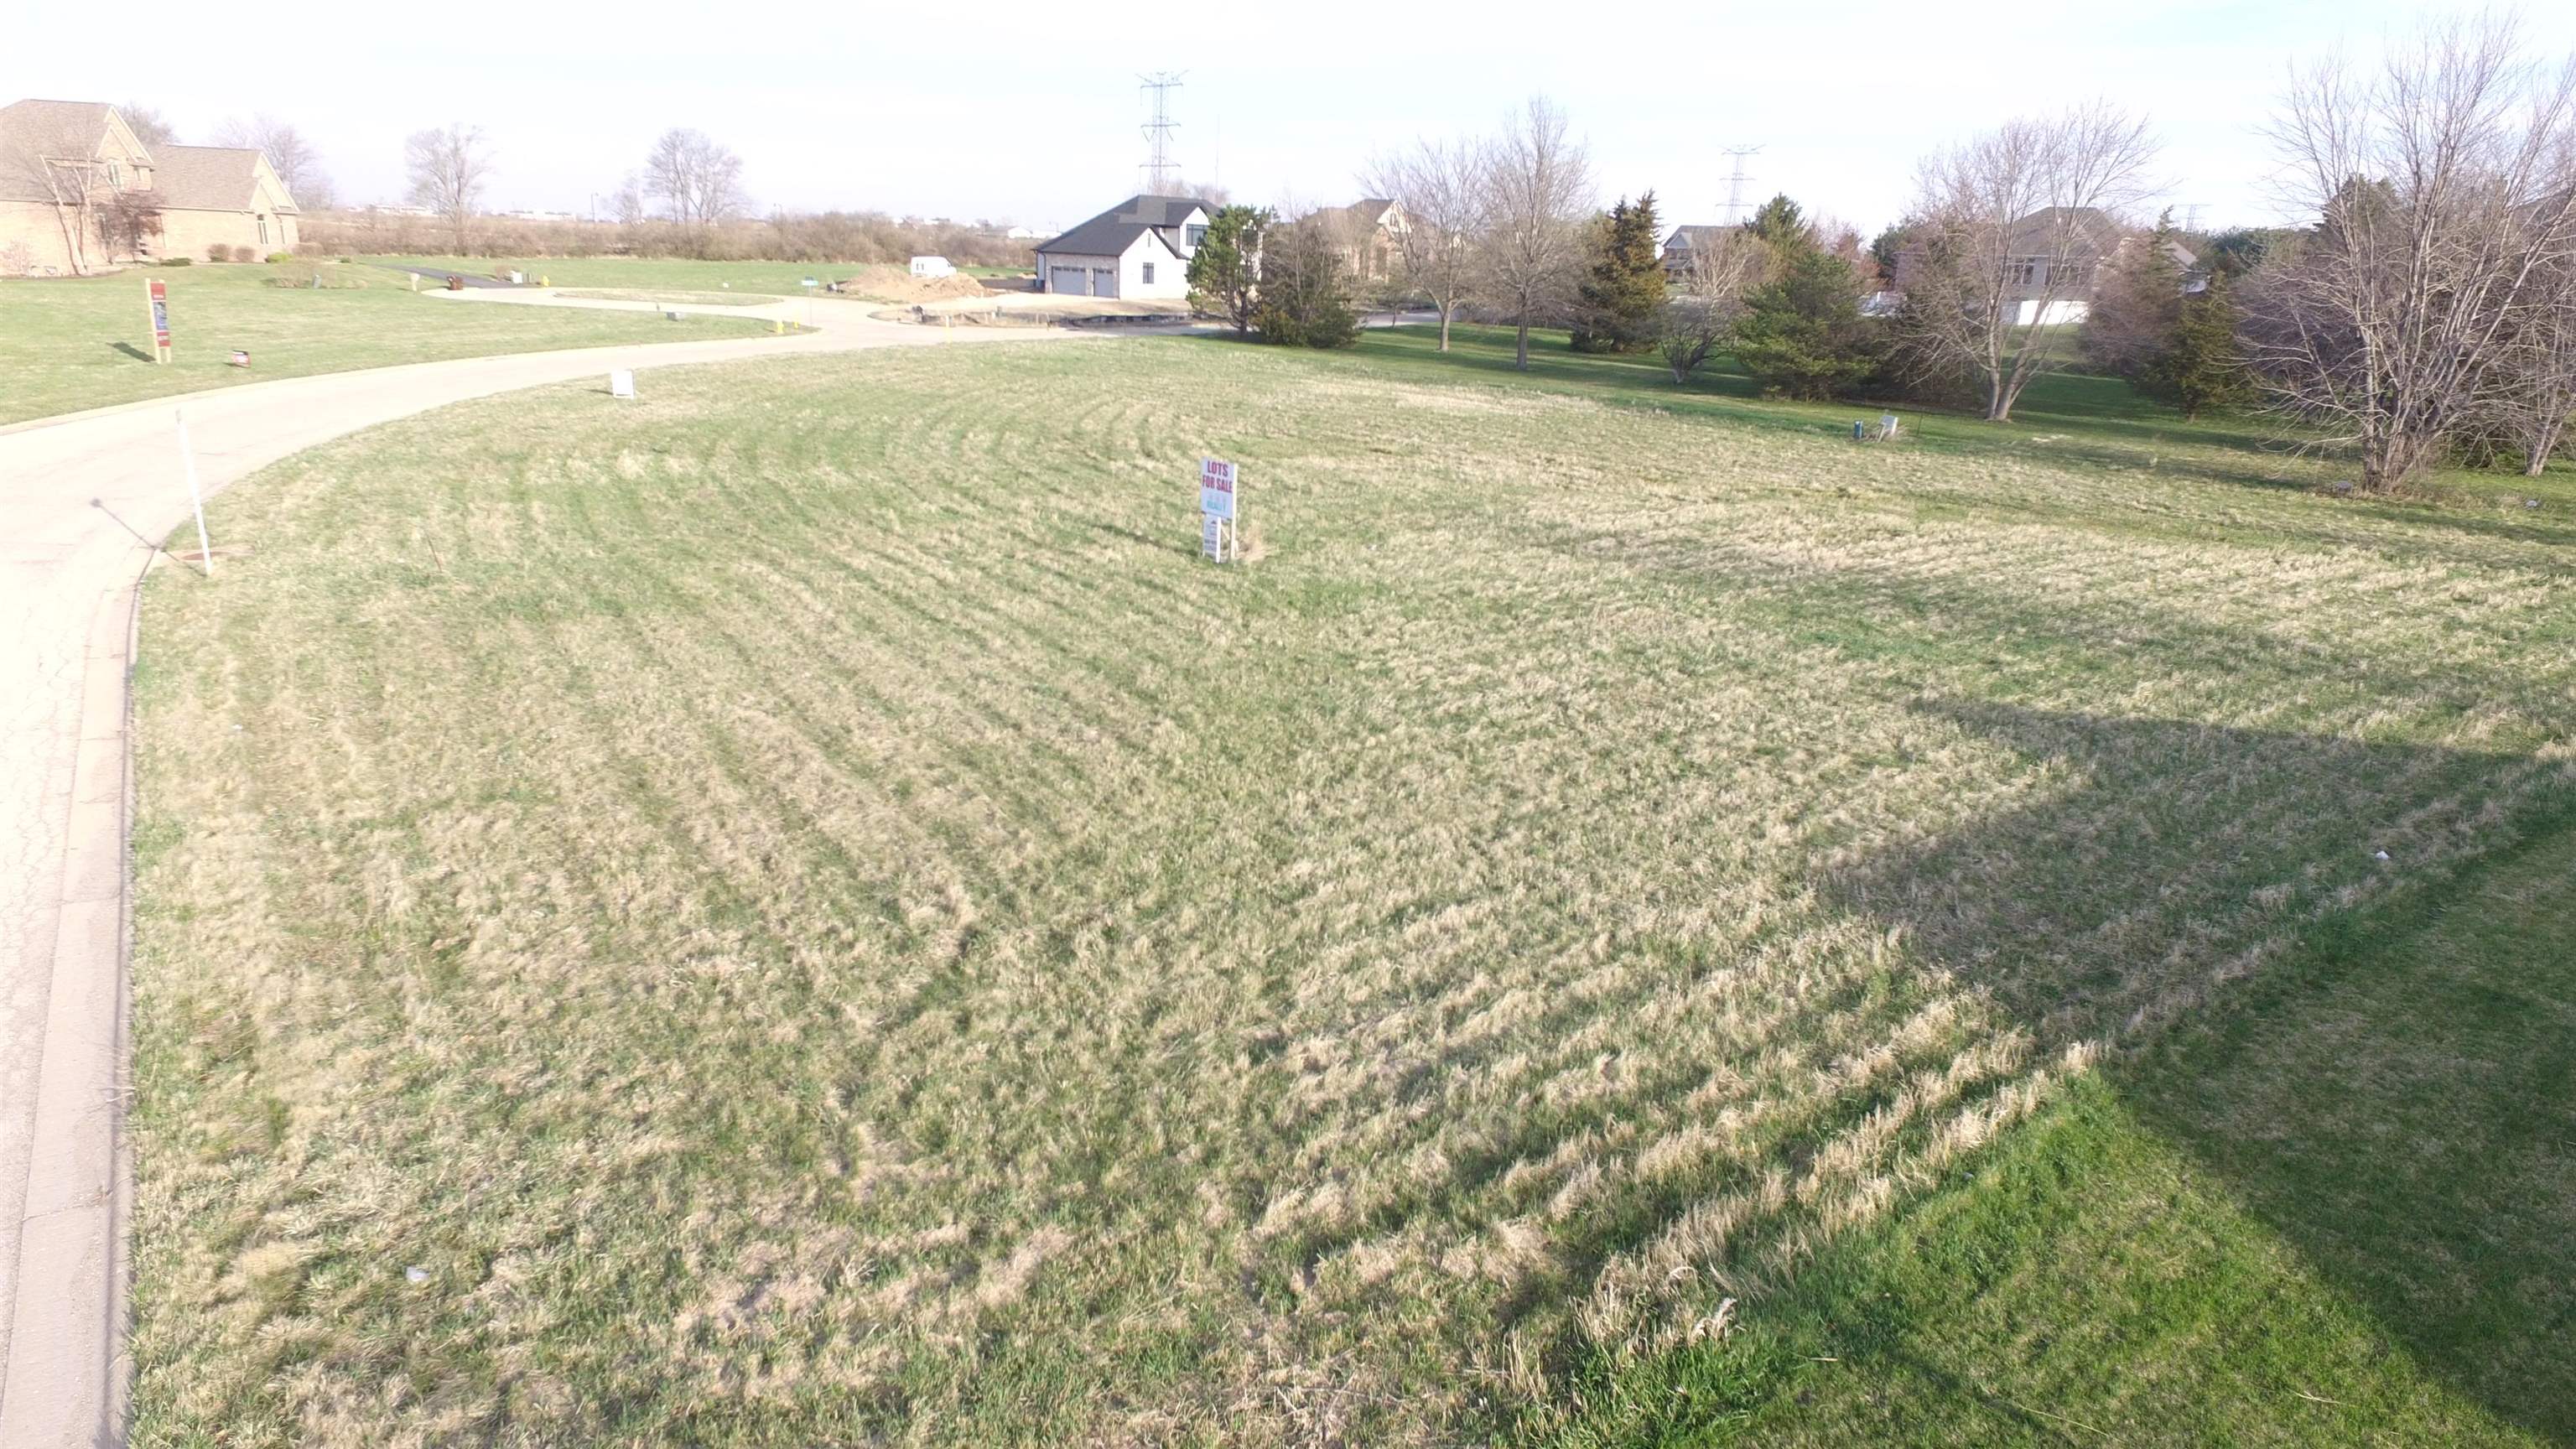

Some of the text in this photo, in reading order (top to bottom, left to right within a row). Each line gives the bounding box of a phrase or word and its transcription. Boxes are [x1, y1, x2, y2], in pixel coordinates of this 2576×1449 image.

[1208, 460, 1228, 477] LOTS
[1202, 475, 1233, 493] FOR SALE
